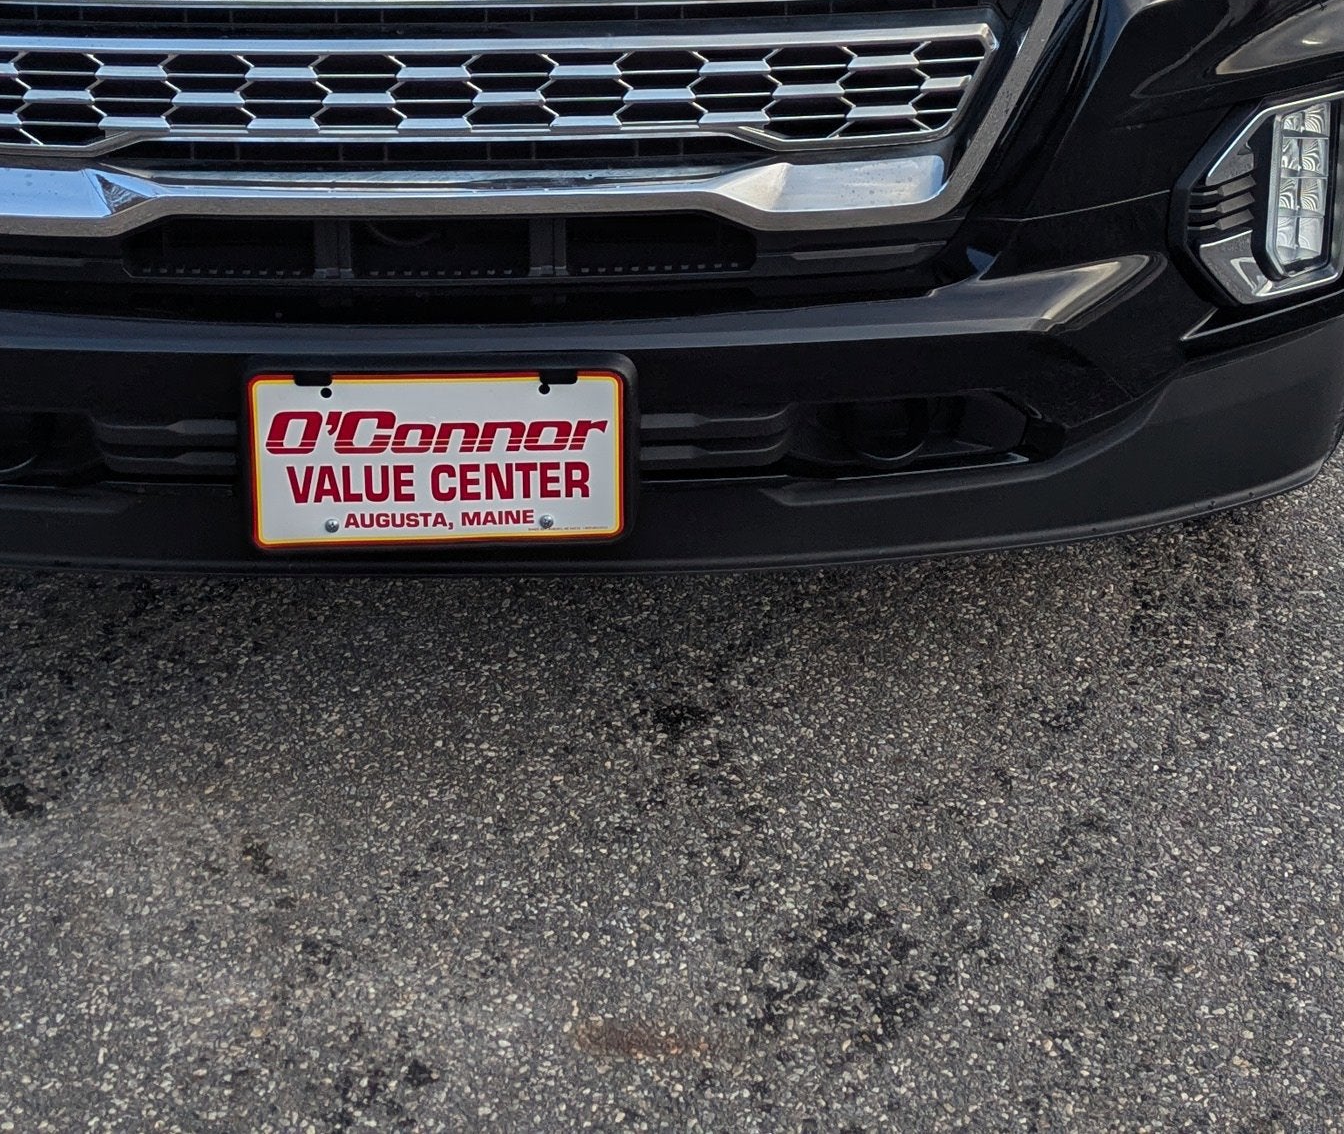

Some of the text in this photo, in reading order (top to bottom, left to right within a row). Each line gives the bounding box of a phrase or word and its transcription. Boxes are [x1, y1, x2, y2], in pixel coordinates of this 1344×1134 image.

[265, 410, 608, 455] O'Connor
[286, 462, 590, 503] VALUE CENTER
[344, 509, 535, 531] AUGUSTA, MAINE
